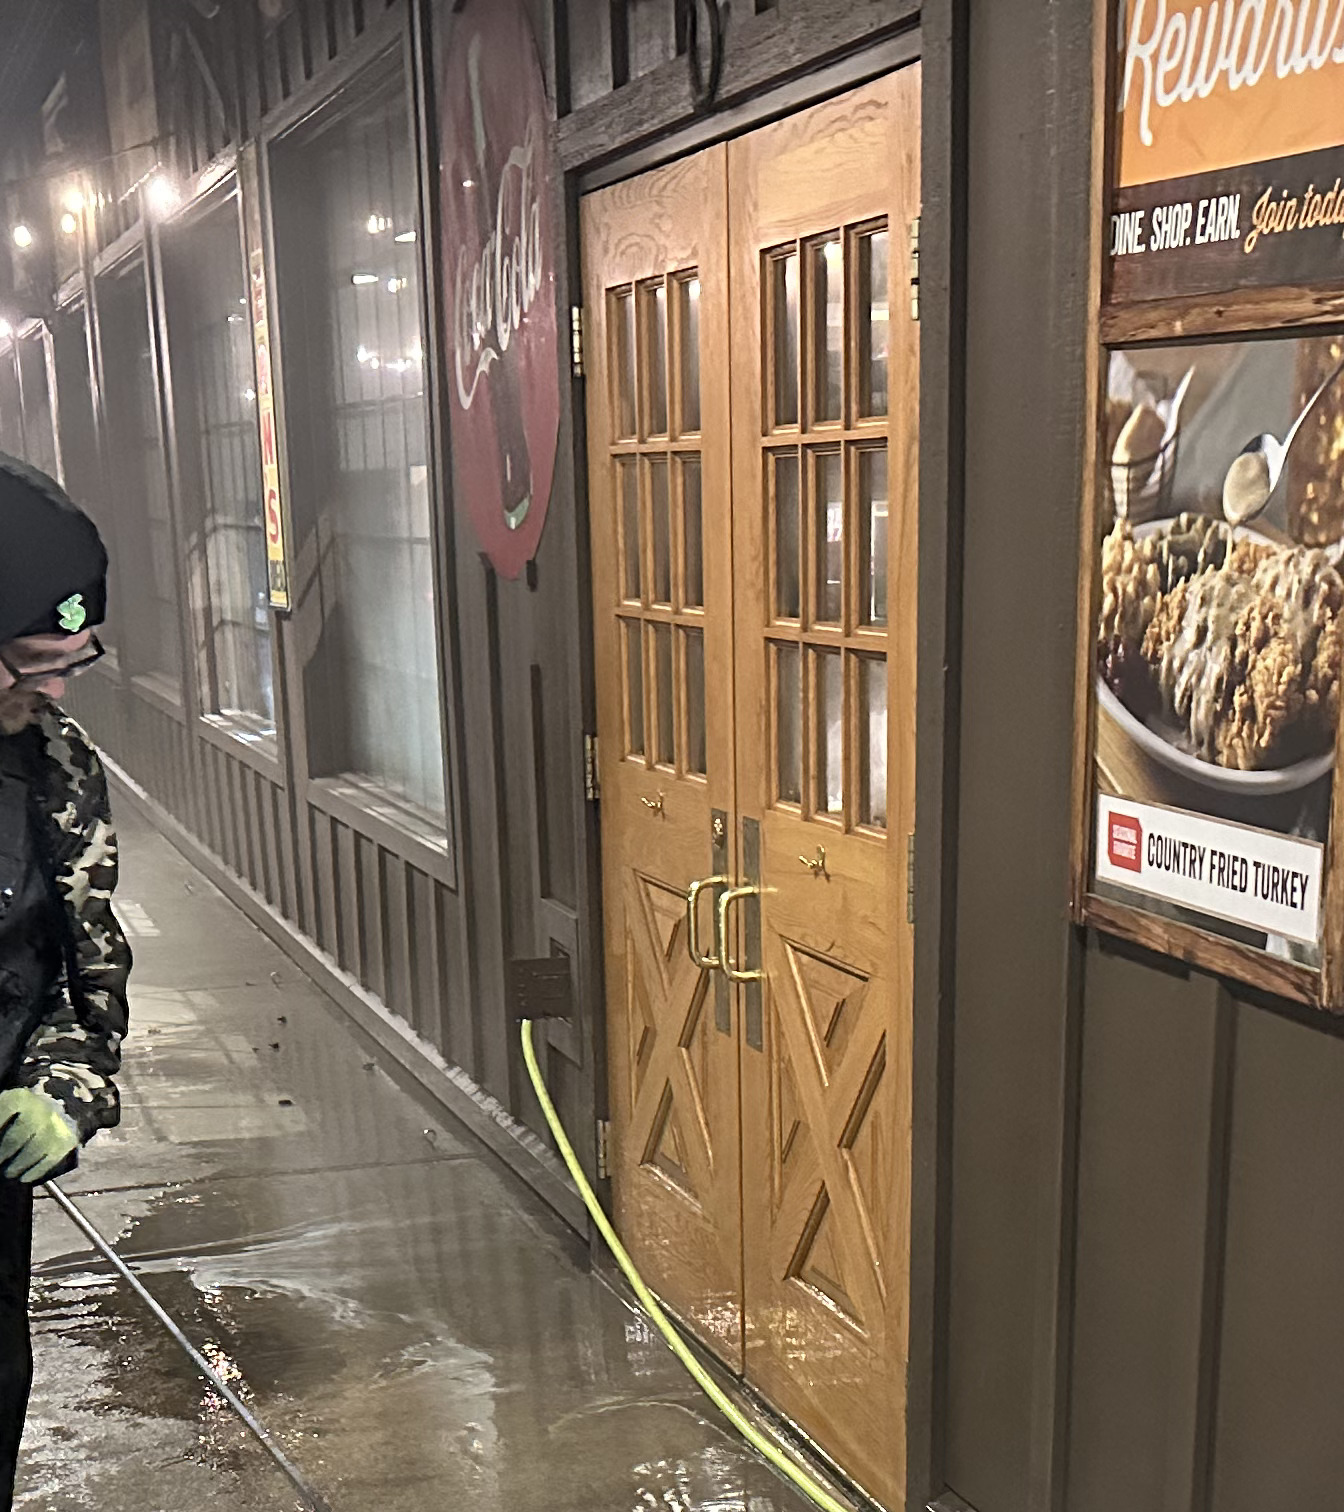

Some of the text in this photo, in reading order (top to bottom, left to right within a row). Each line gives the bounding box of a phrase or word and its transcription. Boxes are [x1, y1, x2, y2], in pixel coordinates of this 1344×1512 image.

[1109, 210, 1146, 256] DINE.
[1150, 202, 1193, 252] SHOP.
[1195, 193, 1241, 245] EARN.
[1244, 186, 1299, 254] Join
[1147, 832, 1207, 881] COUNTRY
[1209, 849, 1248, 893] FRIED
[1253, 861, 1310, 910] TURKEY
